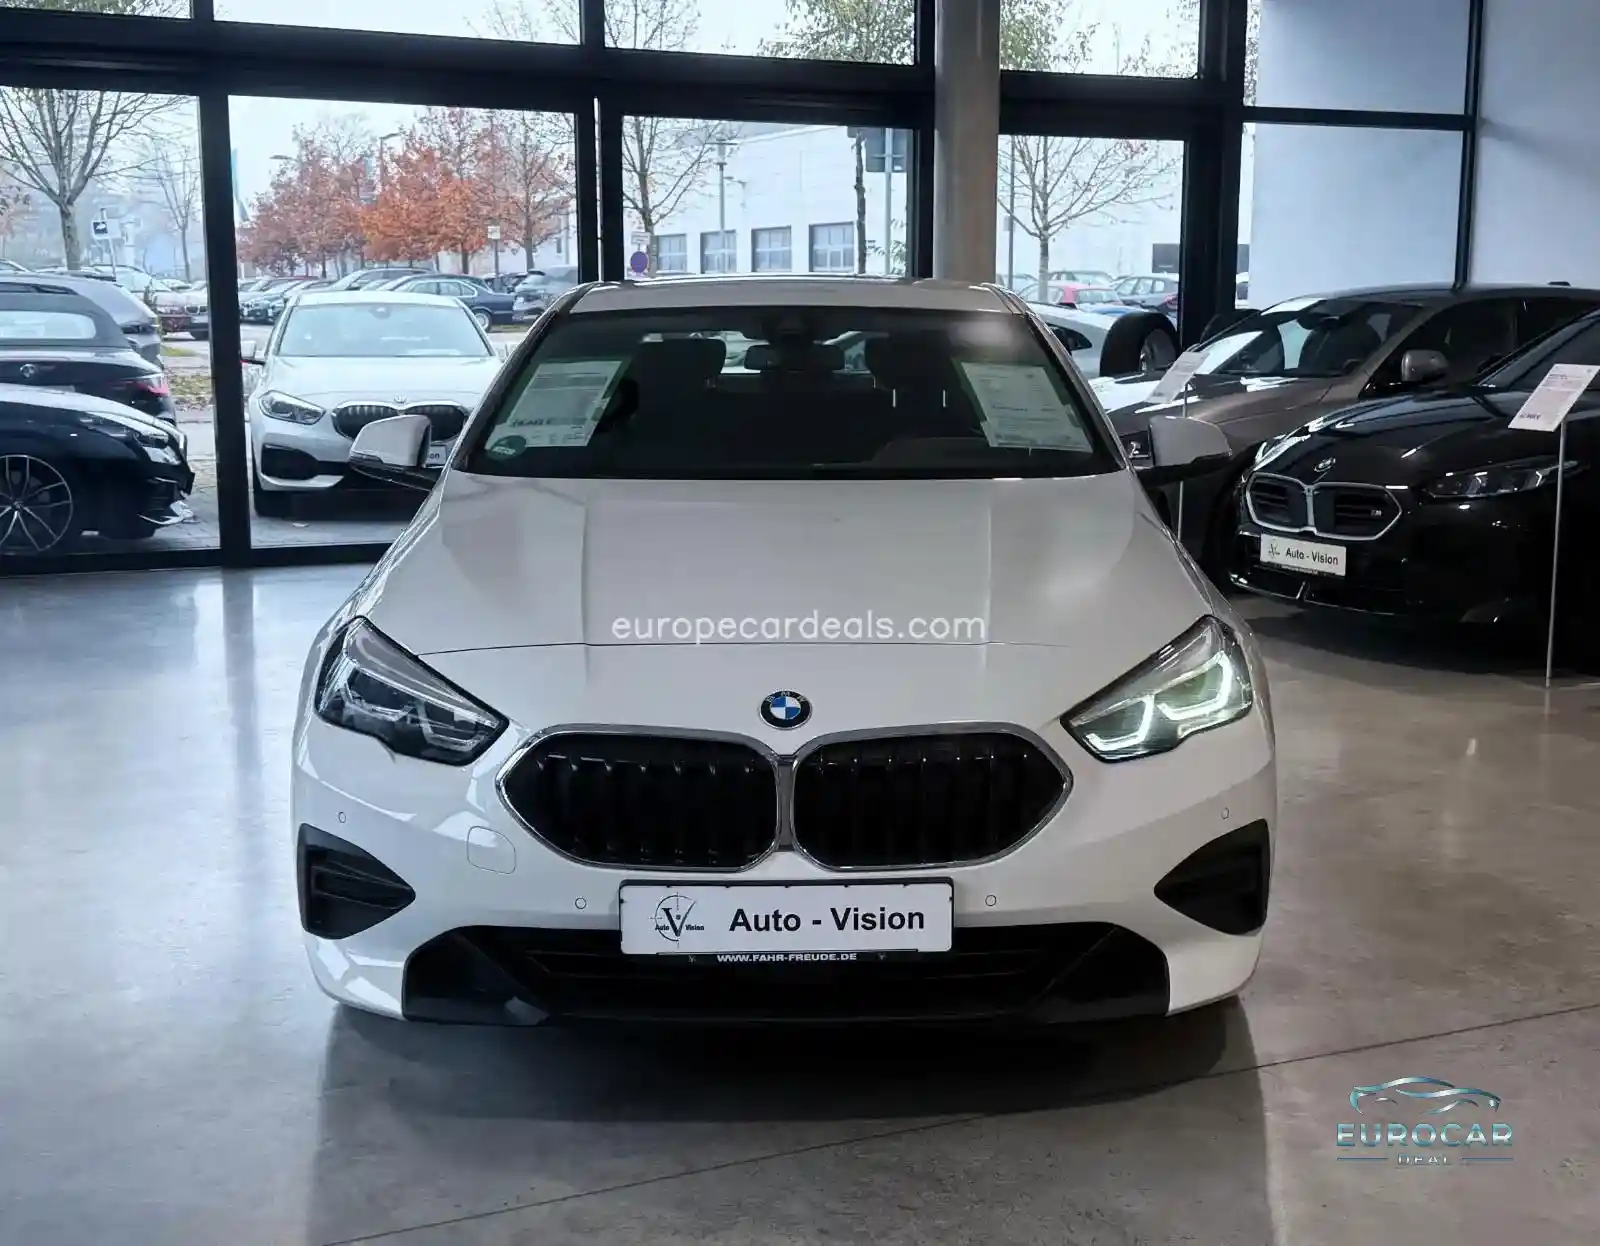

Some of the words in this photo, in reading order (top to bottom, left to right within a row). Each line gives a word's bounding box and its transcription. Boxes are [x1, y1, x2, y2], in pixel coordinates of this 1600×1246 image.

[1285, 547, 1305, 560] Auto
[1312, 551, 1339, 565] Vision
[729, 908, 801, 931] Auto
[830, 907, 925, 930] Vision
[717, 952, 857, 962] WWW.FAHR-FREUDE.DE
